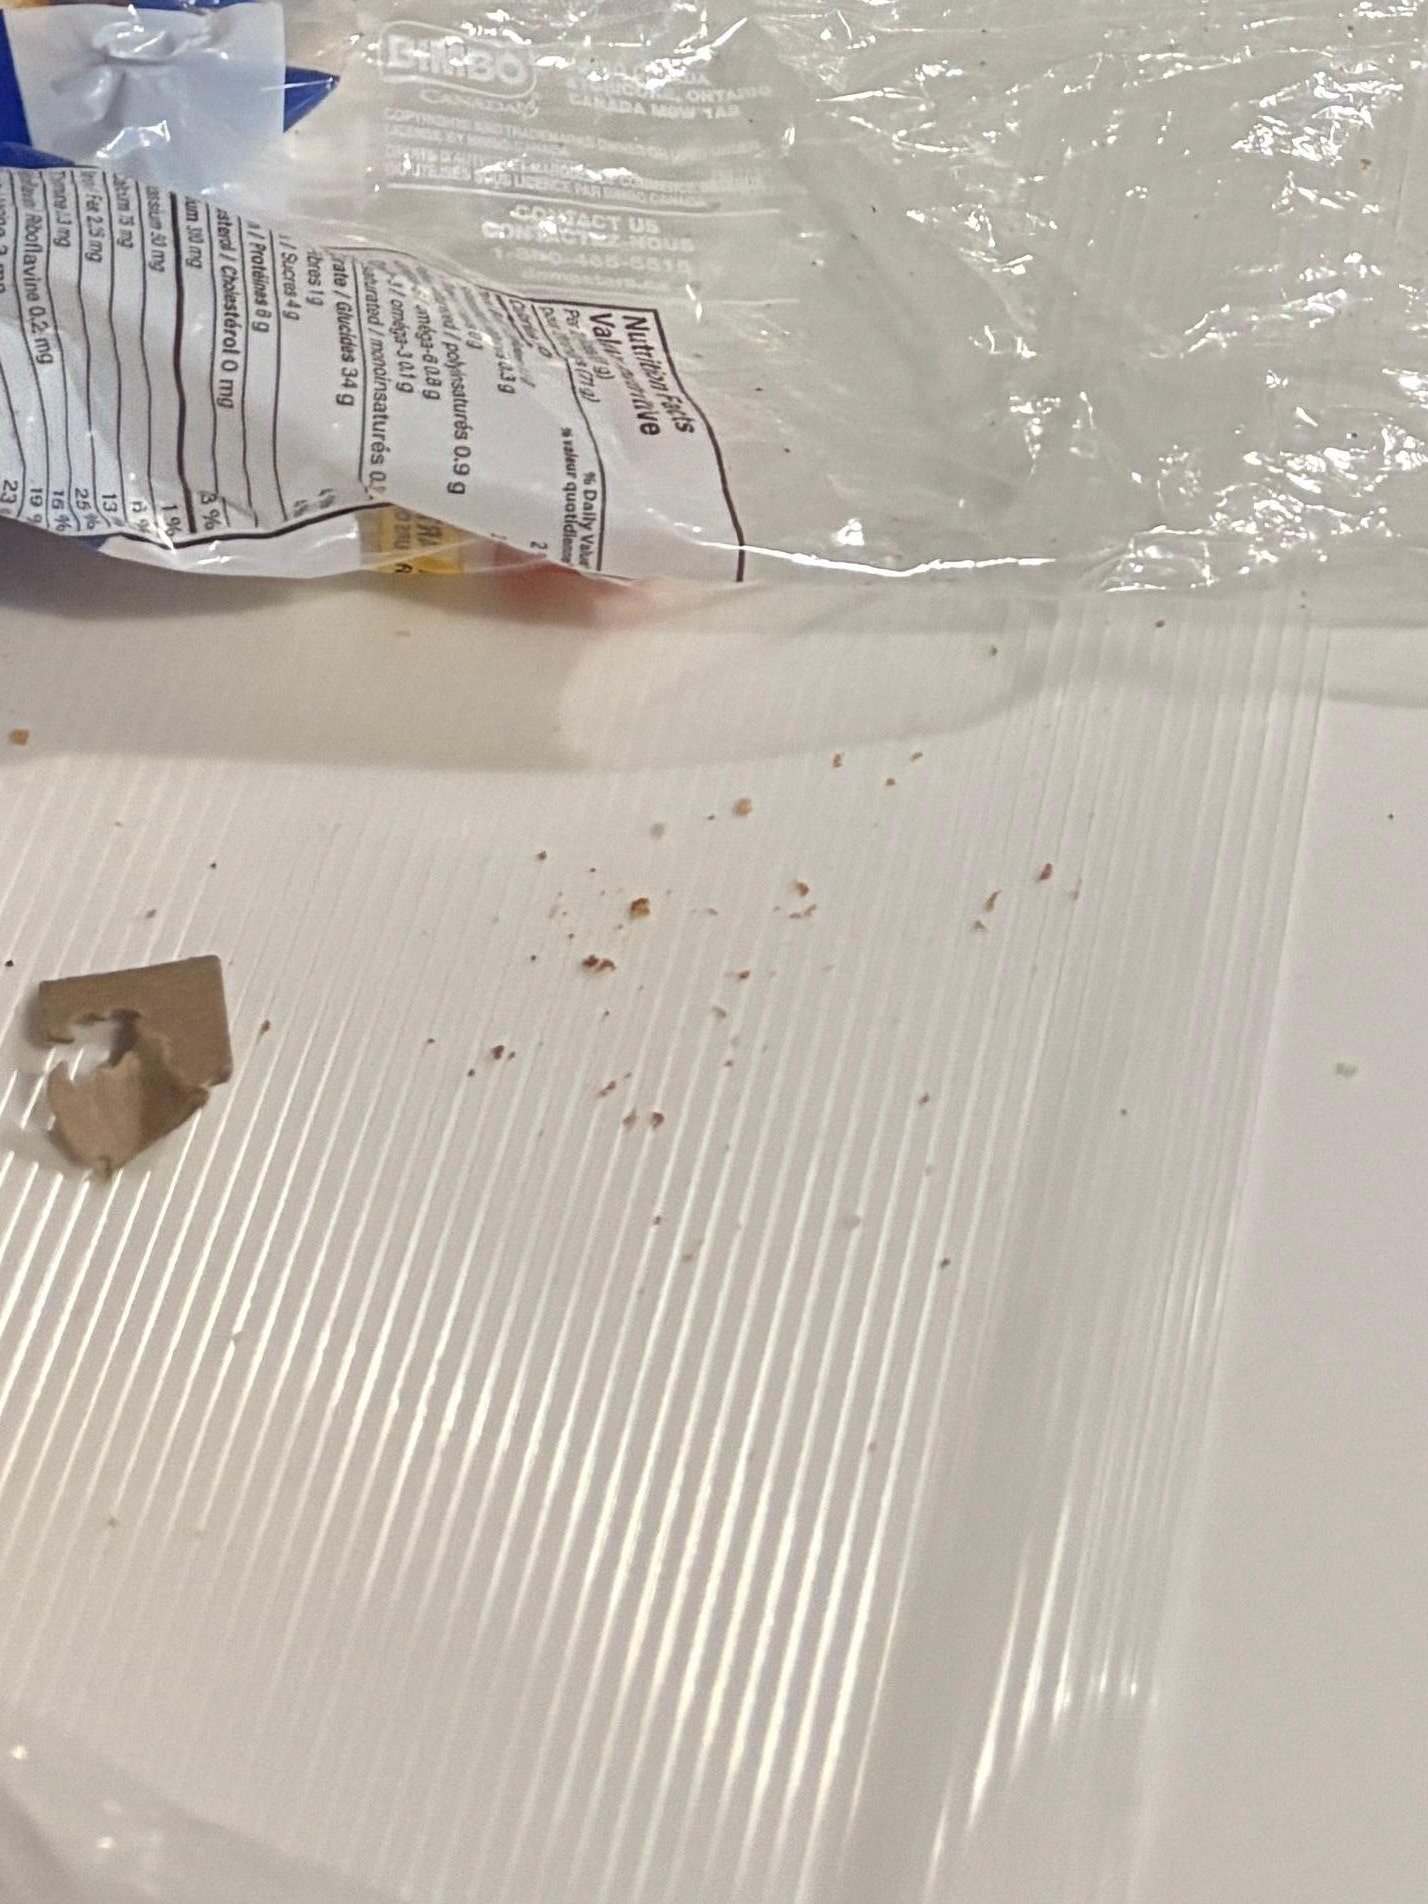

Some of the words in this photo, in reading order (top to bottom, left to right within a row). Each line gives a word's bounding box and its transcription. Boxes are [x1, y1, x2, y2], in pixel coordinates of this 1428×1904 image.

[23, 212, 43, 302] Riboflavine
[84, 241, 103, 263] mg
[249, 242, 268, 306] Protéines
[281, 252, 298, 300] Sucres
[29, 307, 49, 334] 0.2
[221, 266, 242, 355] Cholestérol
[36, 337, 54, 365] mg
[337, 301, 355, 369] Glucides
[217, 379, 234, 410] mg
[341, 369, 358, 390] 34
[443, 340, 475, 445] polyinsaturés
[623, 313, 670, 398] Nutrition
[666, 393, 696, 436] Facts
[371, 341, 392, 466] monoinsaturés
[451, 447, 471, 477] 0.9
[562, 438, 578, 480] valeur
[3, 479, 18, 504] 23
[582, 488, 598, 529] Daily
